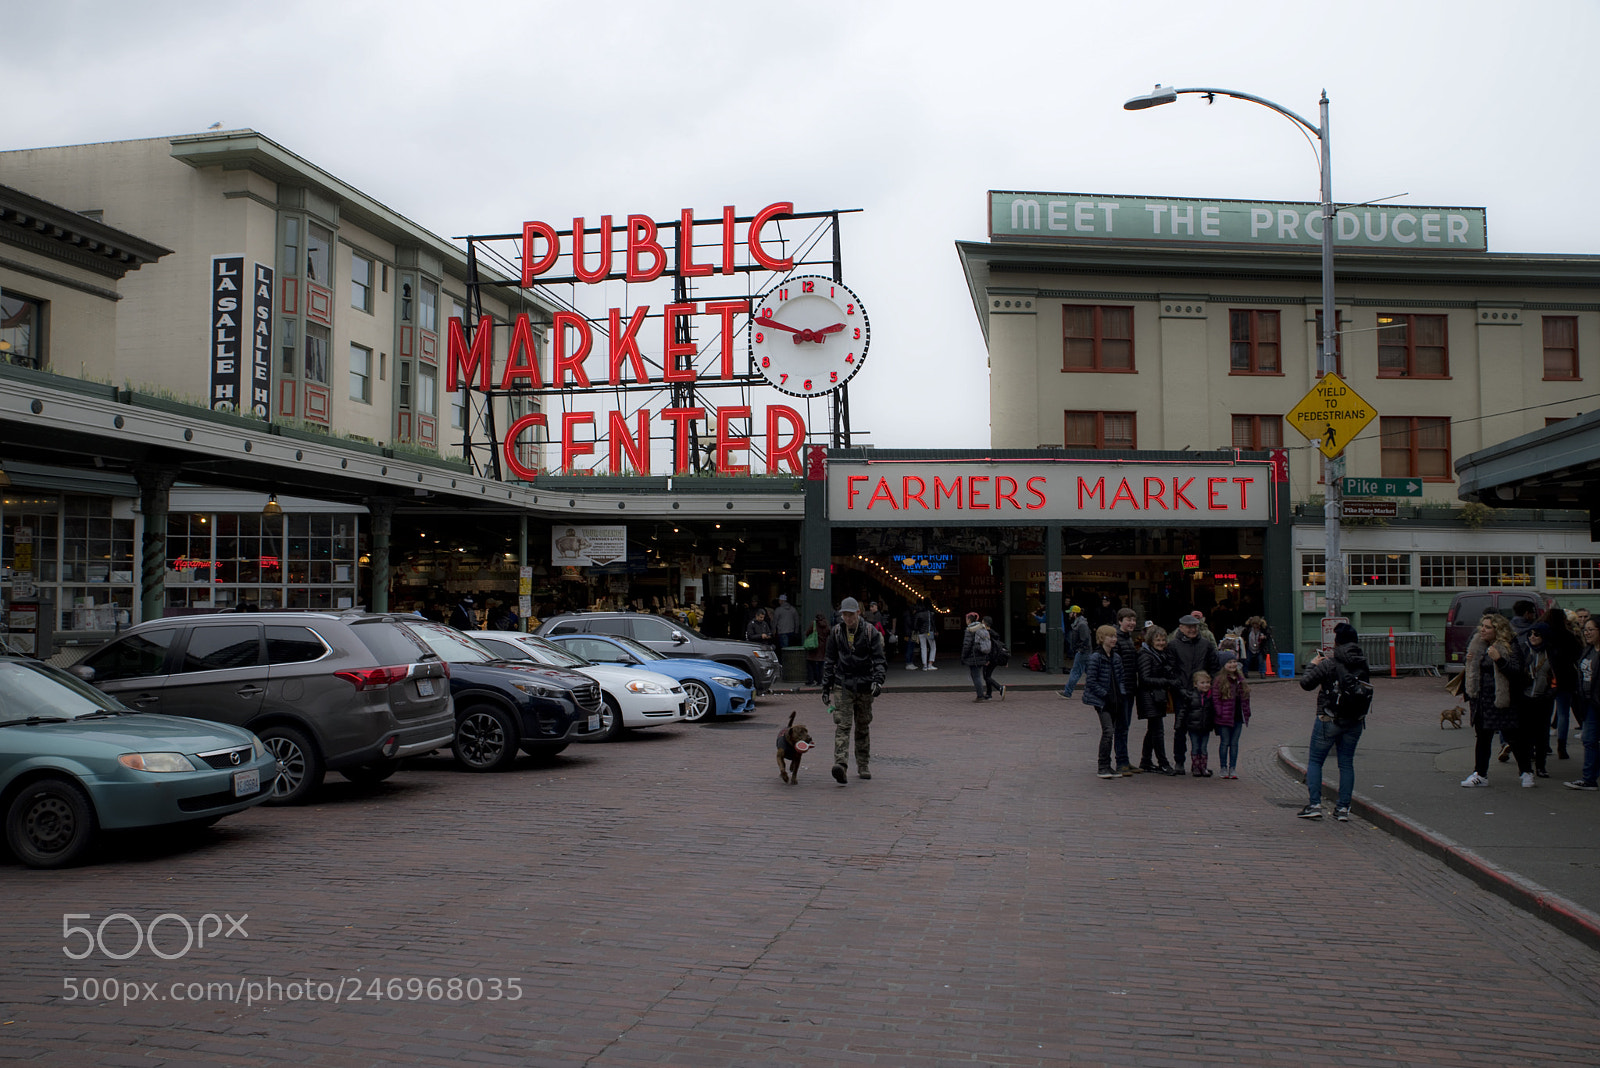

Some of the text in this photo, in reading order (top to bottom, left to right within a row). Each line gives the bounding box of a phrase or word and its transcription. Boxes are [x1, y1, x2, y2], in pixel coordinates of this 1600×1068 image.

[1011, 198, 1469, 244] MEET THE PRODUCER
[521, 201, 794, 288] PUBLIC
[216, 262, 238, 291] LA
[257, 267, 270, 299] LA
[802, 281, 815, 293] 12
[779, 289, 789, 300] 11
[762, 308, 773, 320] 10
[846, 303, 855, 315] 2
[215, 297, 238, 374] SALLE
[756, 332, 764, 344] 9
[853, 328, 861, 339] 3
[254, 306, 269, 380] SALLE
[446, 300, 750, 393] MARKET
[762, 356, 770, 368] 8
[845, 352, 854, 364] 4
[780, 373, 789, 385] 7
[830, 372, 838, 383] 5
[803, 379, 812, 391] 6
[1316, 387, 1347, 397] YIELD
[1325, 399, 1338, 409] TO
[1297, 409, 1366, 422] PEDESTRIANS
[503, 404, 807, 482] CENTER
[847, 475, 1255, 510] FARMERS MARKET
[1347, 479, 1396, 494] Pike Pl
[893, 554, 953, 562] WAERFRONT
